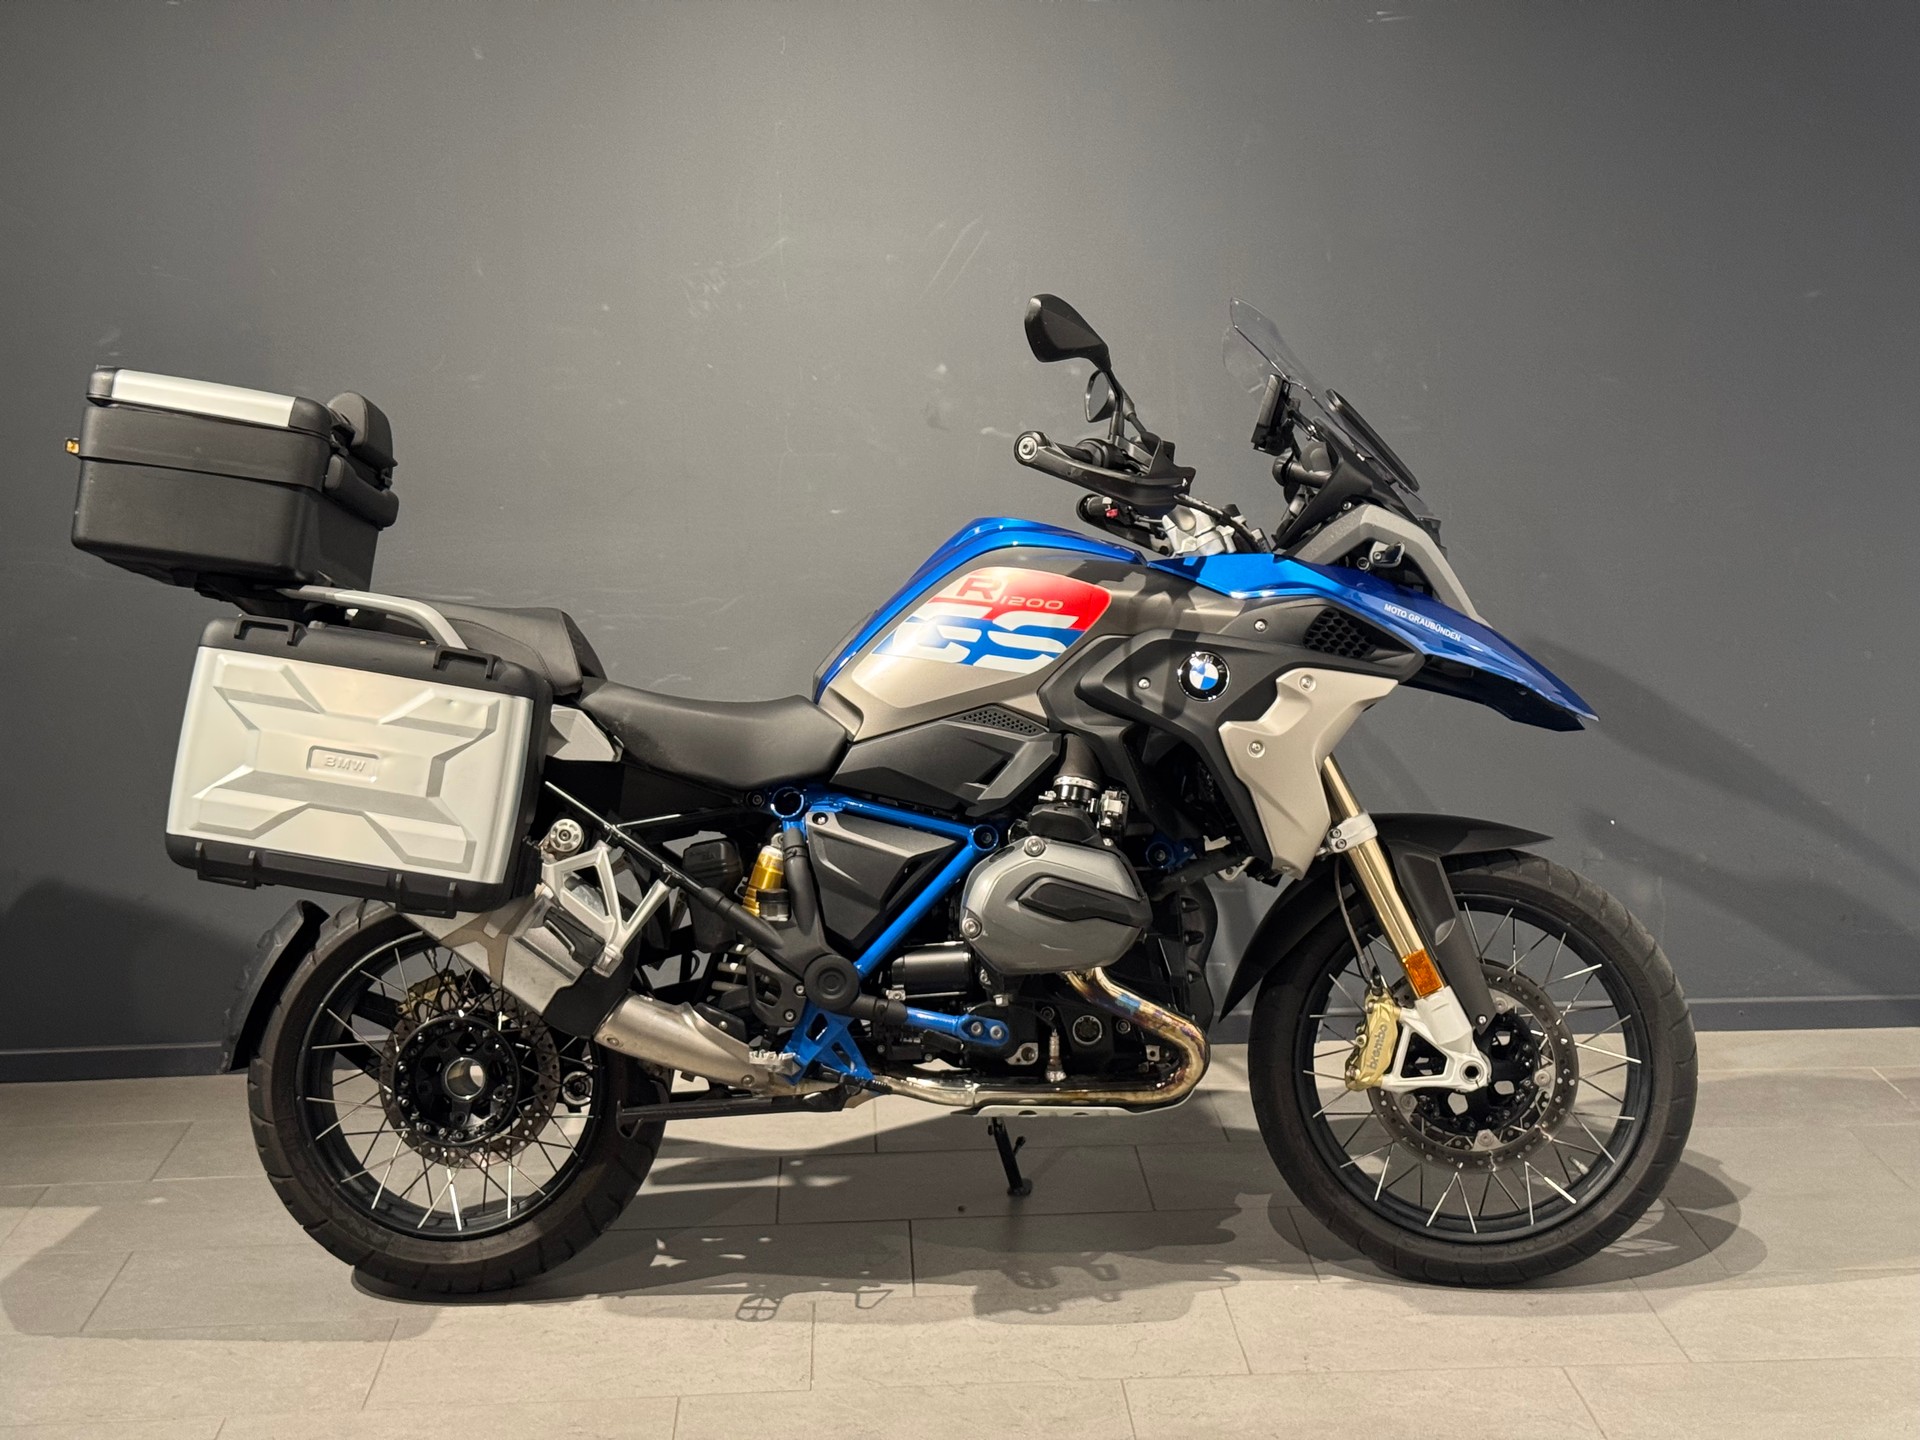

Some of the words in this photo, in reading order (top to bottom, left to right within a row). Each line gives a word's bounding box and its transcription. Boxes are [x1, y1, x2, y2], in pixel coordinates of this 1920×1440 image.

[956, 577, 1001, 600] R
[1000, 595, 1064, 610] 1200
[889, 602, 1080, 675] GS
[1384, 603, 1407, 618] MOTO
[1408, 613, 1461, 641] GRAUBÜNDEN
[324, 755, 366, 772] BMW
[1368, 1024, 1387, 1070] brembo
